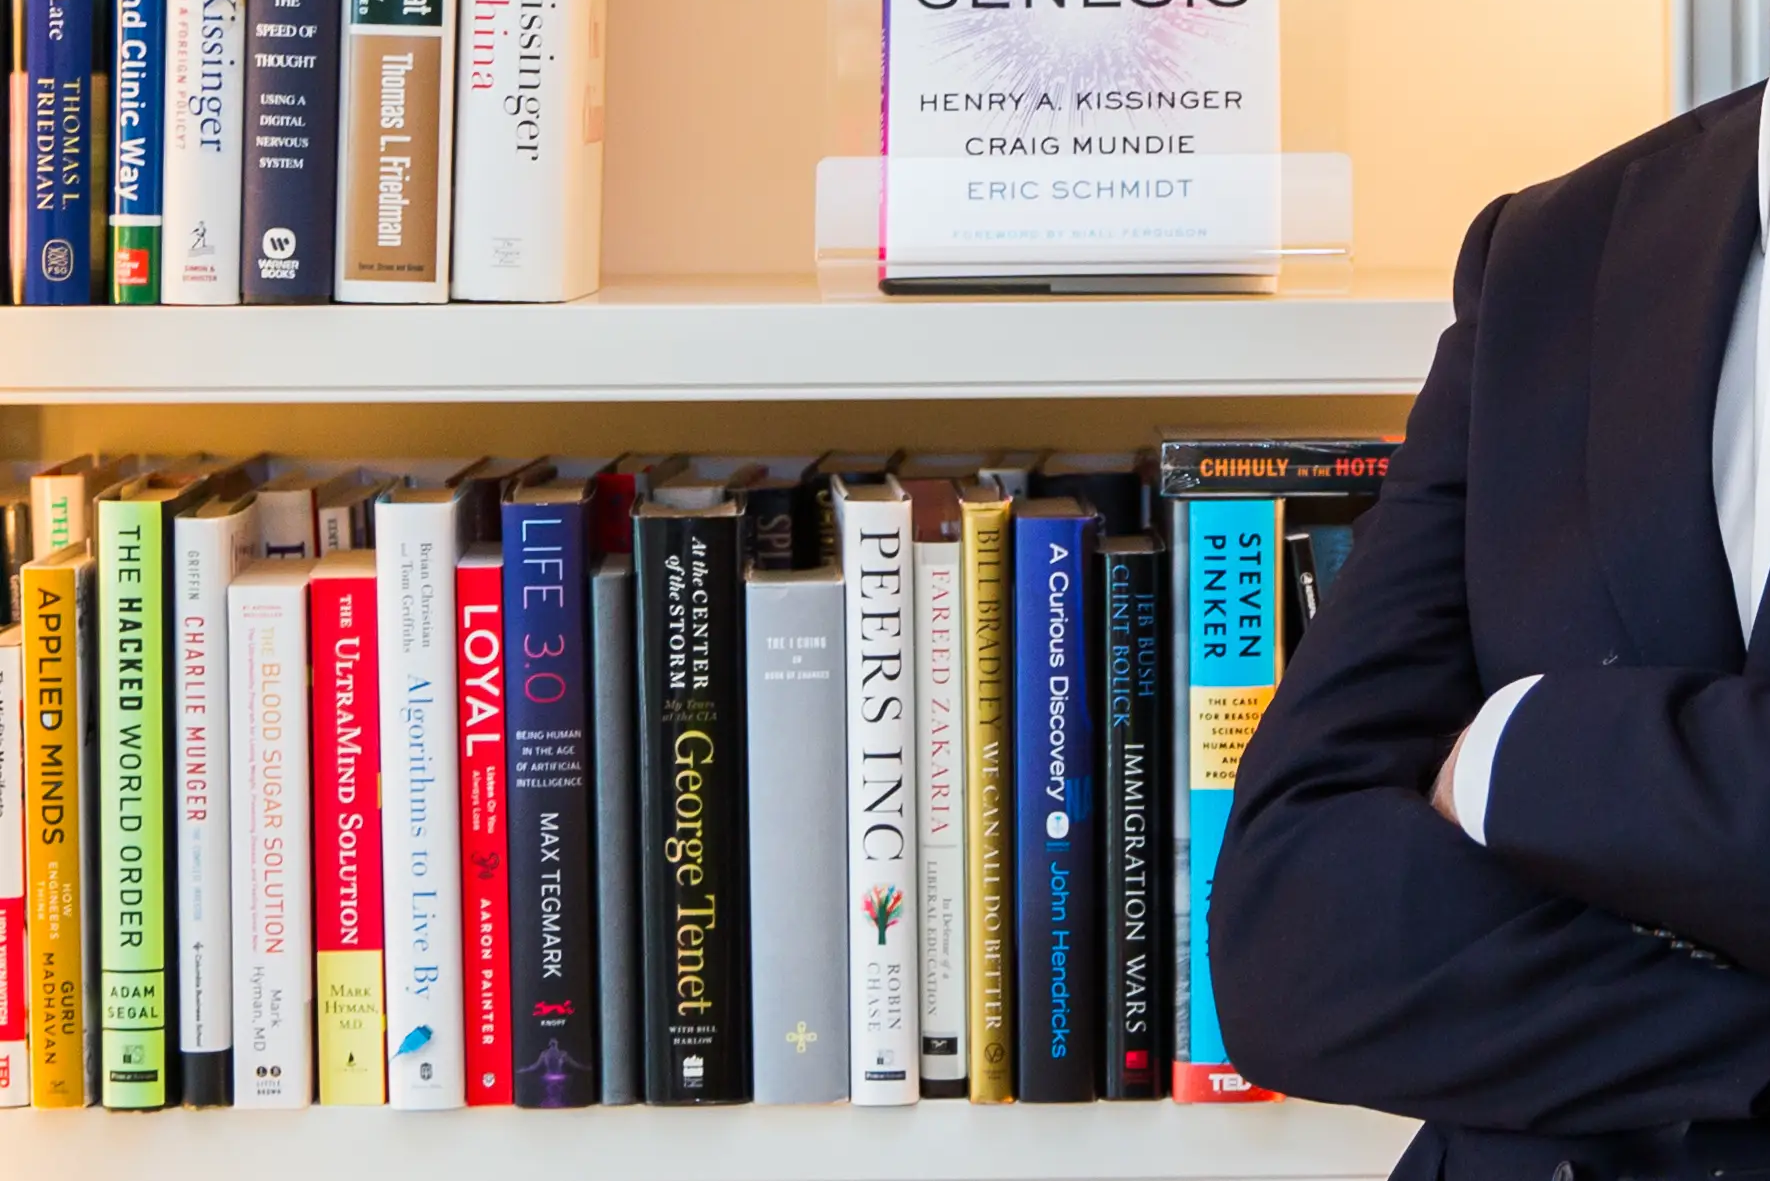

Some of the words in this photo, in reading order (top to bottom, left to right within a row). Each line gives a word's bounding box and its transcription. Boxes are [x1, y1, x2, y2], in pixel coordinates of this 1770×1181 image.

[255, 25, 296, 37] SPEED
[299, 25, 317, 38] OF
[255, 54, 317, 68] THOUGHT
[61, 77, 81, 184] THOMAS
[120, 40, 148, 127] Clinic
[920, 92, 1024, 112] HENRY
[1037, 93, 1062, 112] A.
[1076, 90, 1243, 111] KISSINGER
[36, 78, 54, 210] FRIEDMAN
[114, 137, 146, 200] Way
[965, 136, 1060, 155] CRAIG
[1073, 136, 1195, 154] MUNDIE
[968, 180, 1040, 200] ERIC
[1052, 179, 1194, 198] SCHMIDT
[1200, 458, 1289, 477] CHIHULY
[119, 525, 141, 585] THE
[522, 520, 562, 609] LIFE
[1049, 543, 1067, 563] A
[1204, 536, 1226, 659] PINKER
[1239, 533, 1262, 658] STEVEN
[38, 588, 63, 730] APPLIED
[119, 597, 143, 711] HACKED
[185, 616, 206, 715] CHARLIE
[860, 527, 901, 724] PEERS
[932, 570, 949, 686] FAREED
[1049, 571, 1069, 668] Curious
[464, 604, 500, 756] LOYAL
[524, 634, 566, 704] 3.0
[119, 725, 142, 832] WORLD
[186, 728, 207, 822] MUNGER
[400, 674, 437, 838] Algorithms
[931, 699, 949, 836] ZAKARIA
[1047, 676, 1069, 801] Discovery
[42, 744, 65, 846] MINDS
[540, 812, 558, 862] MAX
[665, 730, 714, 885] George
[862, 749, 904, 862] INC
[1124, 743, 1145, 943] IMMIGRATION
[119, 844, 143, 949] ORDER
[338, 812, 363, 945] SOLUTION
[410, 850, 428, 877] to
[1051, 862, 1070, 921] John
[411, 889, 438, 953] Live
[479, 898, 492, 960] AARON
[540, 869, 562, 979] TEGMARK
[677, 894, 716, 1016] Tenet
[108, 1005, 158, 1020] SEGAL
[110, 986, 155, 999] ADAM
[405, 965, 439, 1000] By
[481, 970, 494, 1046] PAINTER
[1051, 929, 1070, 1059] Hendricks
[1126, 954, 1146, 1033] WARS
